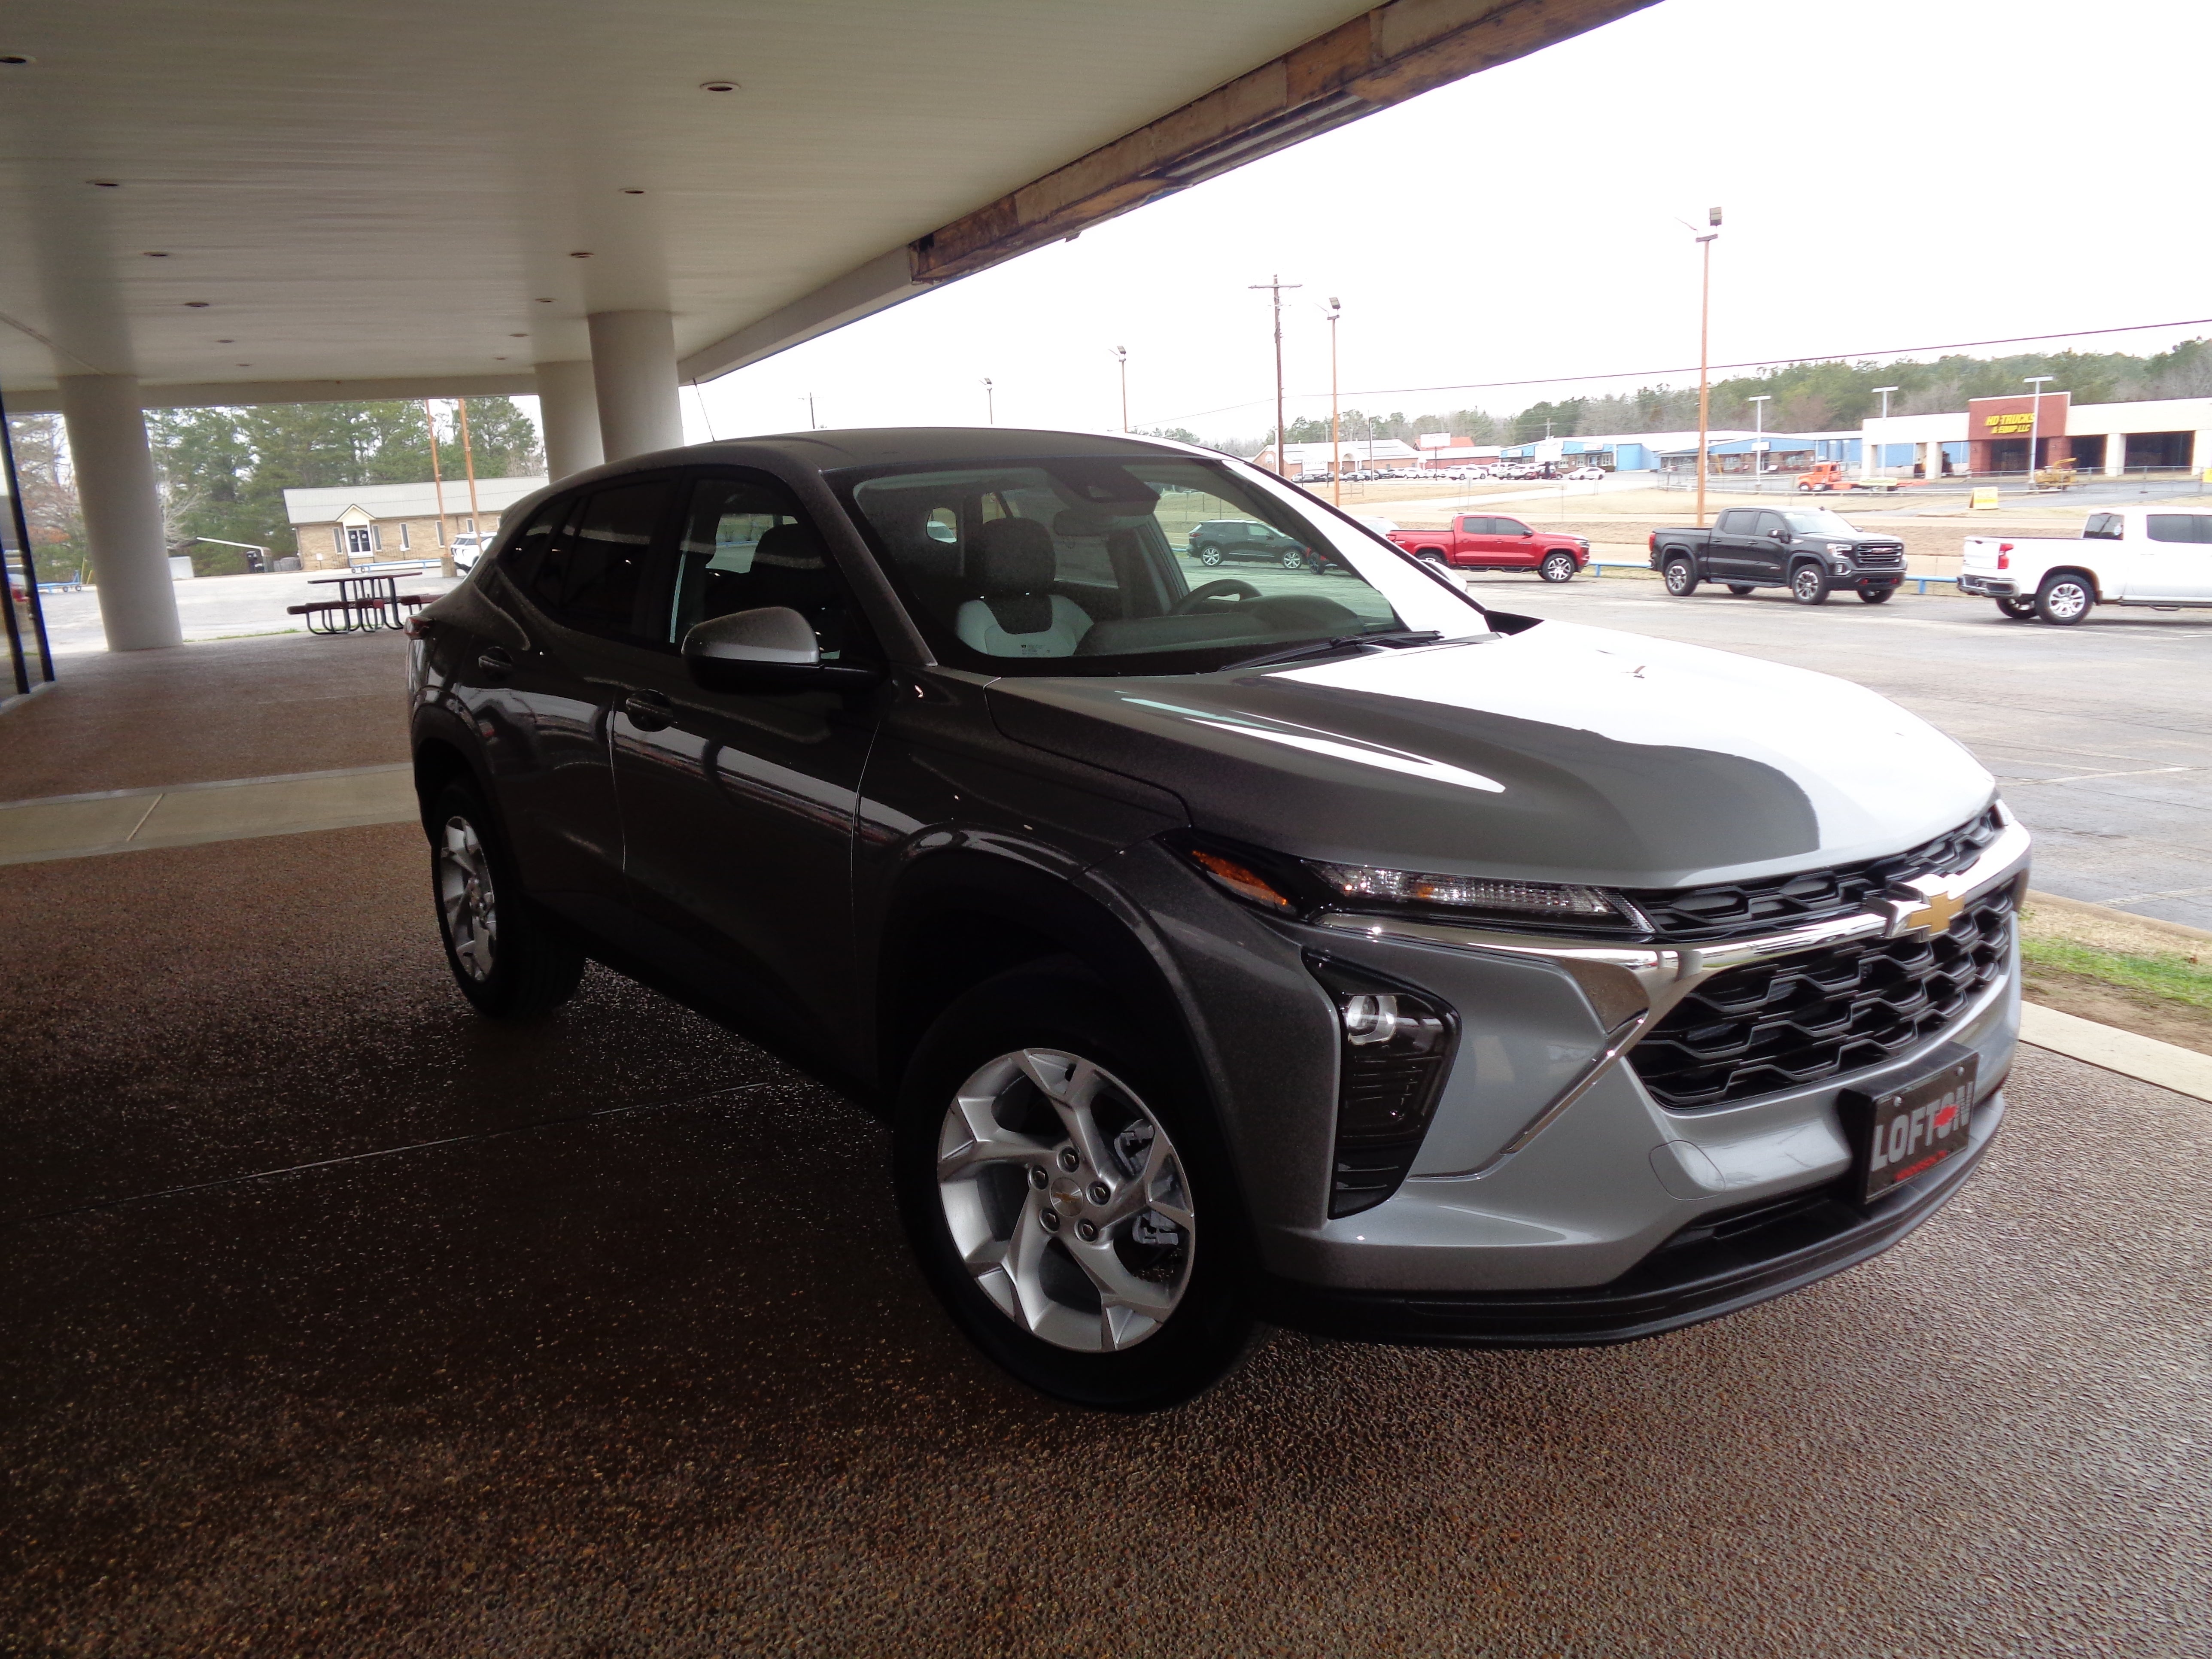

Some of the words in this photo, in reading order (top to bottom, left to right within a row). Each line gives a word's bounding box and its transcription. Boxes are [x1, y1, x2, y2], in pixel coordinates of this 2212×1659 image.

[1985, 415, 1999, 425] HD
[2001, 413, 2035, 424] TRUCKS
[2018, 424, 2031, 432] LLC
